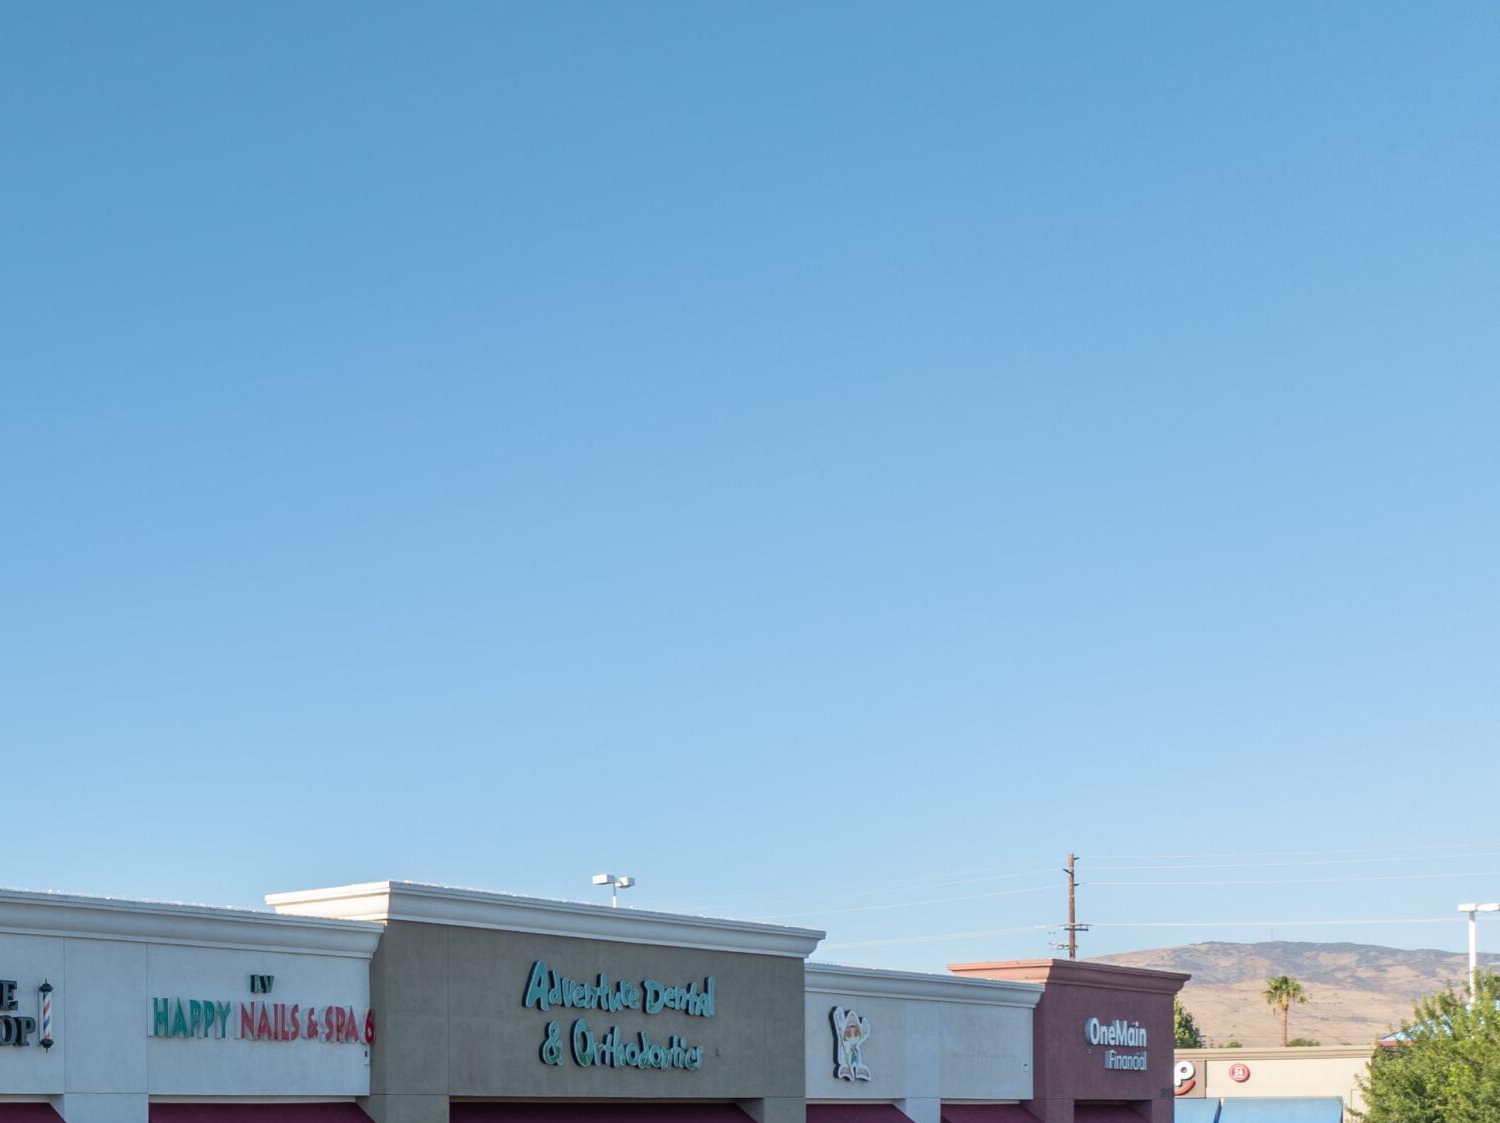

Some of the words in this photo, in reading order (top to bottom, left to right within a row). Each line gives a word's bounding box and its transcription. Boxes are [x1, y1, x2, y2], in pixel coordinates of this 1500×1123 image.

[523, 960, 640, 1013] Adventure
[640, 976, 716, 1017] Dental
[148, 997, 231, 1040] HAPPY
[236, 1001, 300, 1041] NAILS
[303, 1007, 318, 1039] &
[320, 1006, 359, 1043] SPA
[1086, 1017, 1147, 1047] OneMain
[540, 1021, 563, 1066] &
[571, 1019, 703, 1071] Orthodontics
[1106, 1050, 1147, 1070] Financial
